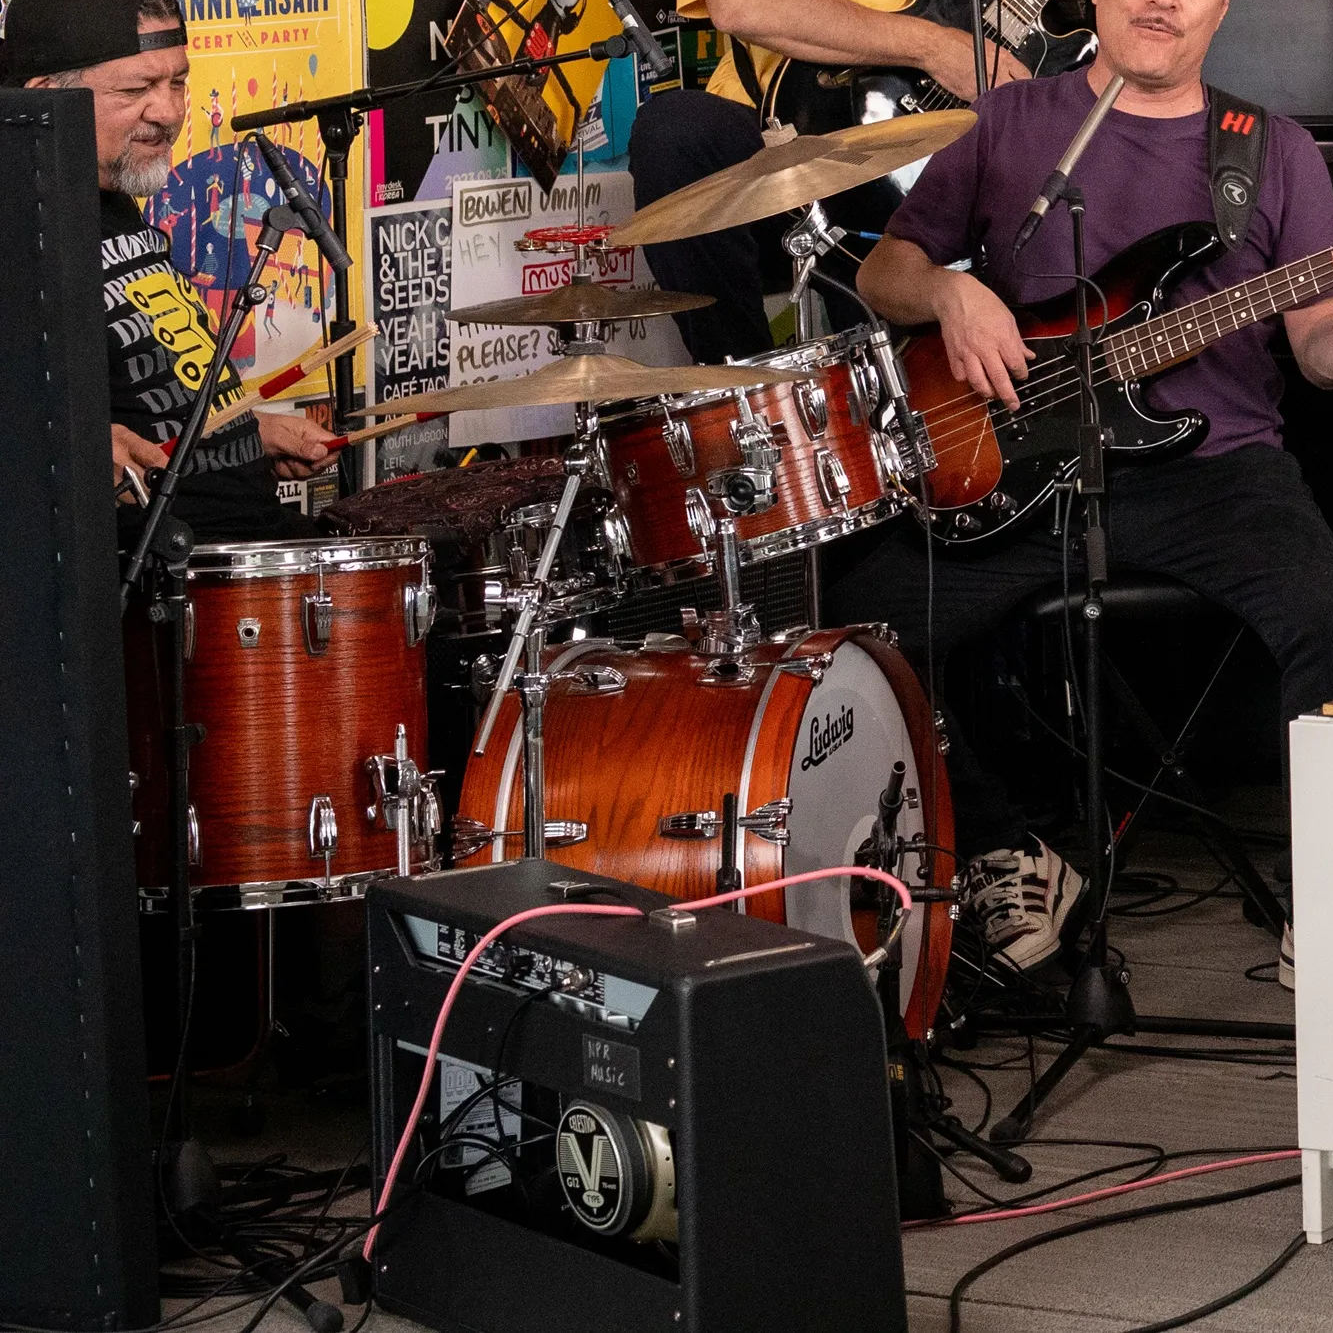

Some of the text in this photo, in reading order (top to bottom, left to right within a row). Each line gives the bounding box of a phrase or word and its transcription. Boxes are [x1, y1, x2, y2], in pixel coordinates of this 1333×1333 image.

[261, 28, 310, 45] PARTY
[425, 112, 495, 155] TINY
[1221, 111, 1255, 136] HI
[379, 189, 402, 201] KOREA
[463, 188, 527, 221] BOWEN
[378, 217, 428, 255] NICK
[459, 230, 502, 267] HEY
[378, 249, 432, 284] & THE
[379, 275, 450, 312] SEEDS
[379, 315, 437, 348] YEAH
[381, 339, 450, 376] YEAHS
[457, 330, 541, 373] PLEASE?
[383, 428, 448, 448] YOUTH LAGOON
[800, 704, 854, 772] Ludwig
[587, 1040, 610, 1061] NPR
[566, 1176, 580, 1187] G12
[586, 1194, 601, 1204] TYPE
